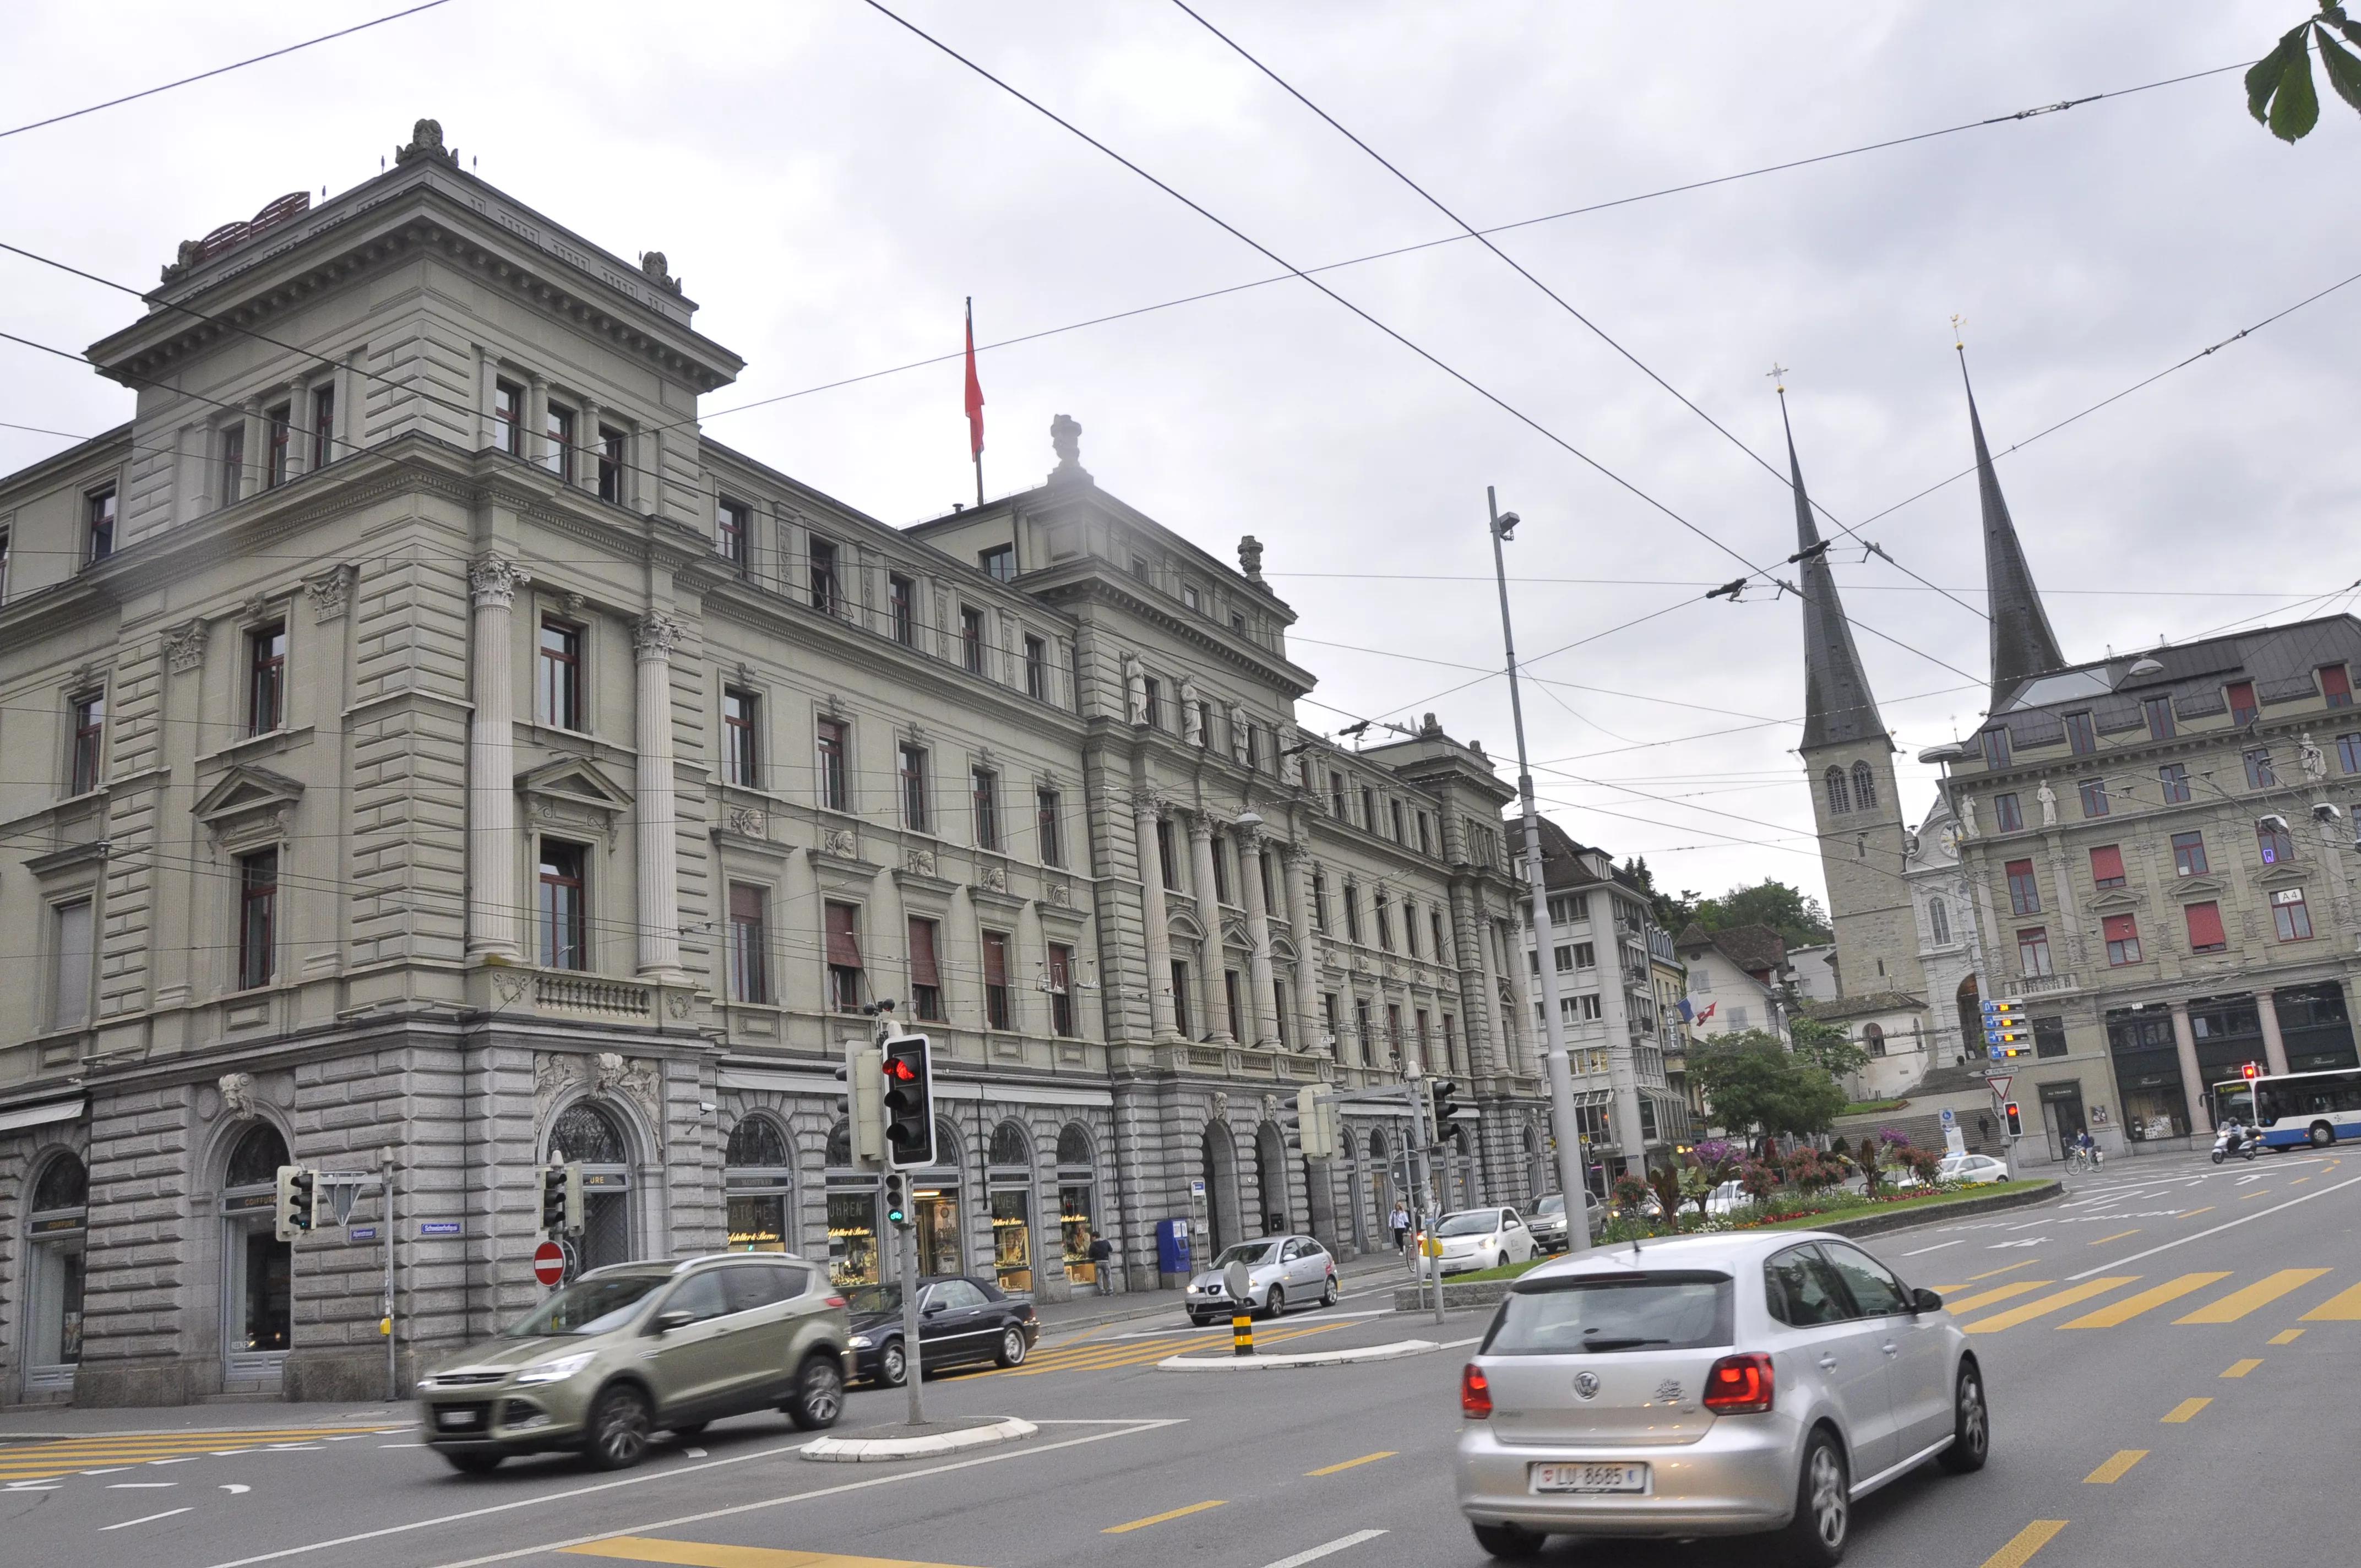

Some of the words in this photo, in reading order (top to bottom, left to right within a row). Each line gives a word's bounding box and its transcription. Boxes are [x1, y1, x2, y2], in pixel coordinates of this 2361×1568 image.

[1666, 1010, 1678, 1048] HOTEL
[727, 1204, 777, 1221] ATCHES
[828, 1201, 863, 1217] UHREN
